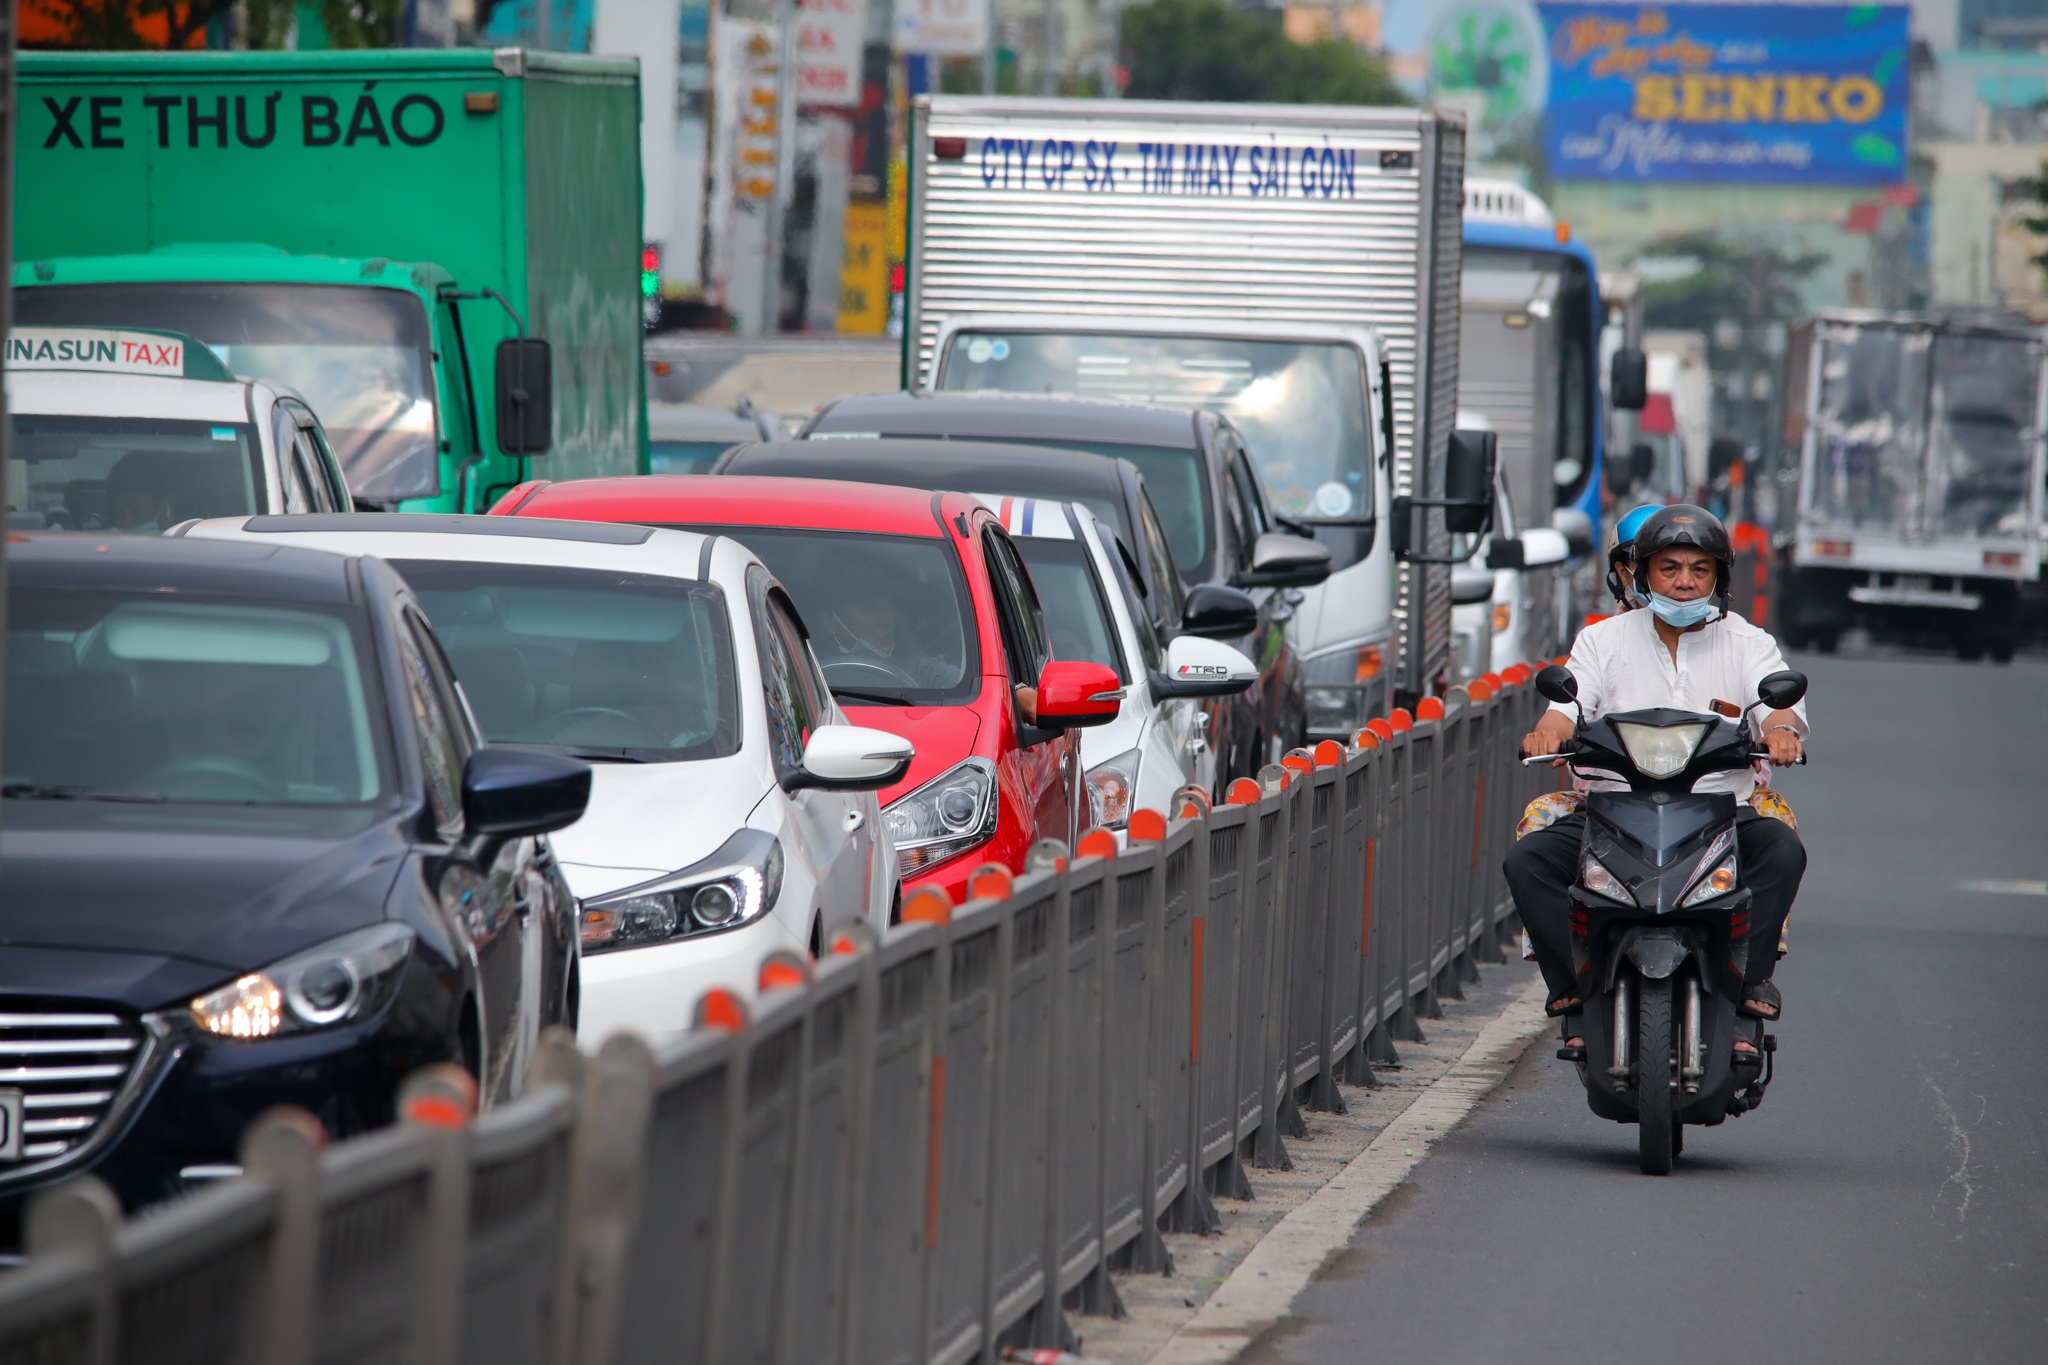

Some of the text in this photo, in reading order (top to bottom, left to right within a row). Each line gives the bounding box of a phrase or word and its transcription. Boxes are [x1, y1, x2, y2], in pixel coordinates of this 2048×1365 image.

[42, 80, 446, 149] XE THƯ BÁO
[1634, 72, 1884, 124] SENKO
[981, 137, 1033, 188] CTY
[1041, 139, 1076, 190] CP
[1084, 140, 1118, 192] SX
[1139, 142, 1175, 195] TM
[1183, 144, 1240, 196] MAY
[1248, 133, 1291, 197] SÀI
[1301, 134, 1357, 199] GÒN
[6, 339, 179, 367] INASUN TAXI
[1191, 665, 1228, 675] TRD
